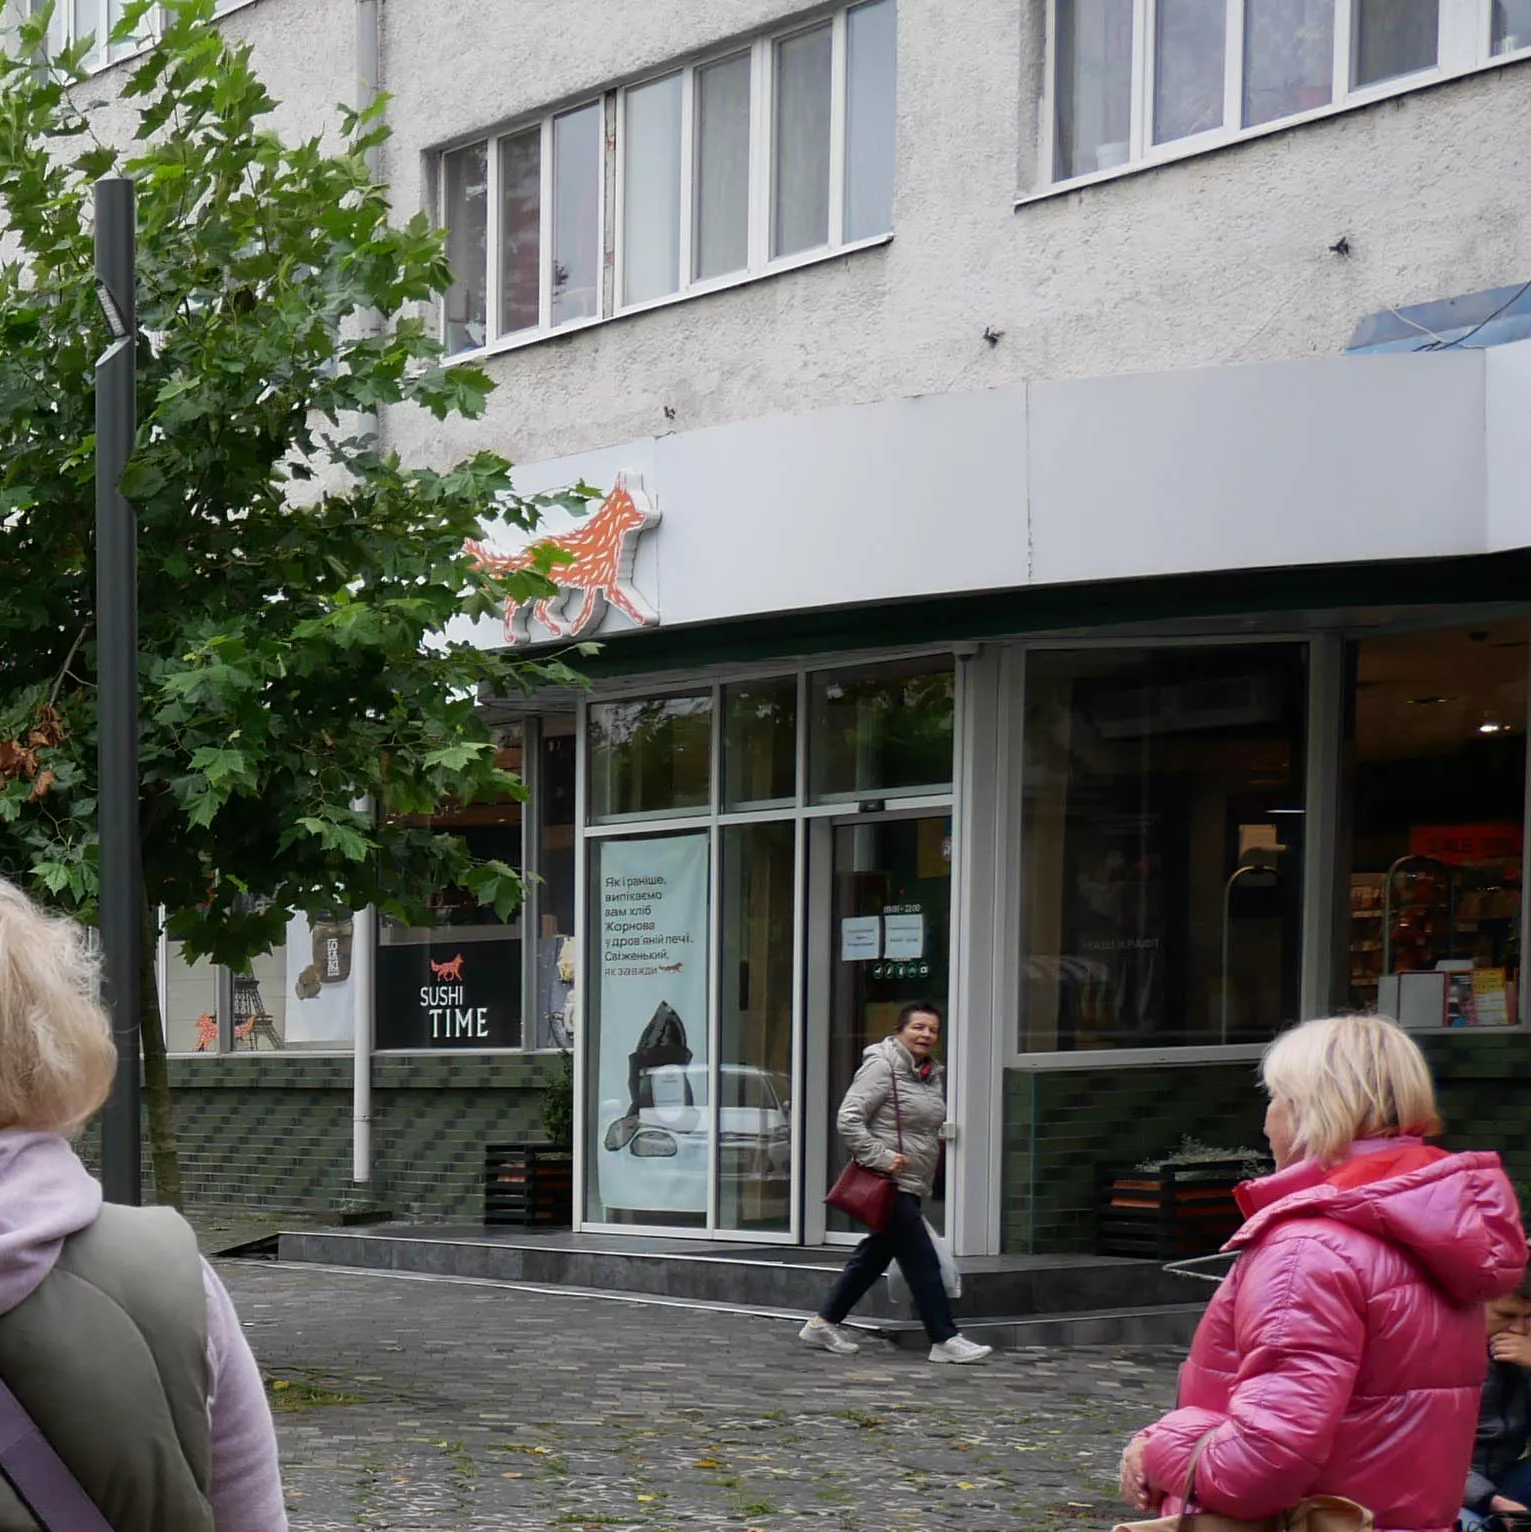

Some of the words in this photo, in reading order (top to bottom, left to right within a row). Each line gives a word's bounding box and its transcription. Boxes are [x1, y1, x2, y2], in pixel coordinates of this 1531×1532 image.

[604, 908, 627, 918] вам
[629, 904, 652, 916] хліб
[605, 920, 656, 934] Жорнова
[420, 986, 463, 1006] SUSHI
[429, 1007, 489, 1038] TIME
